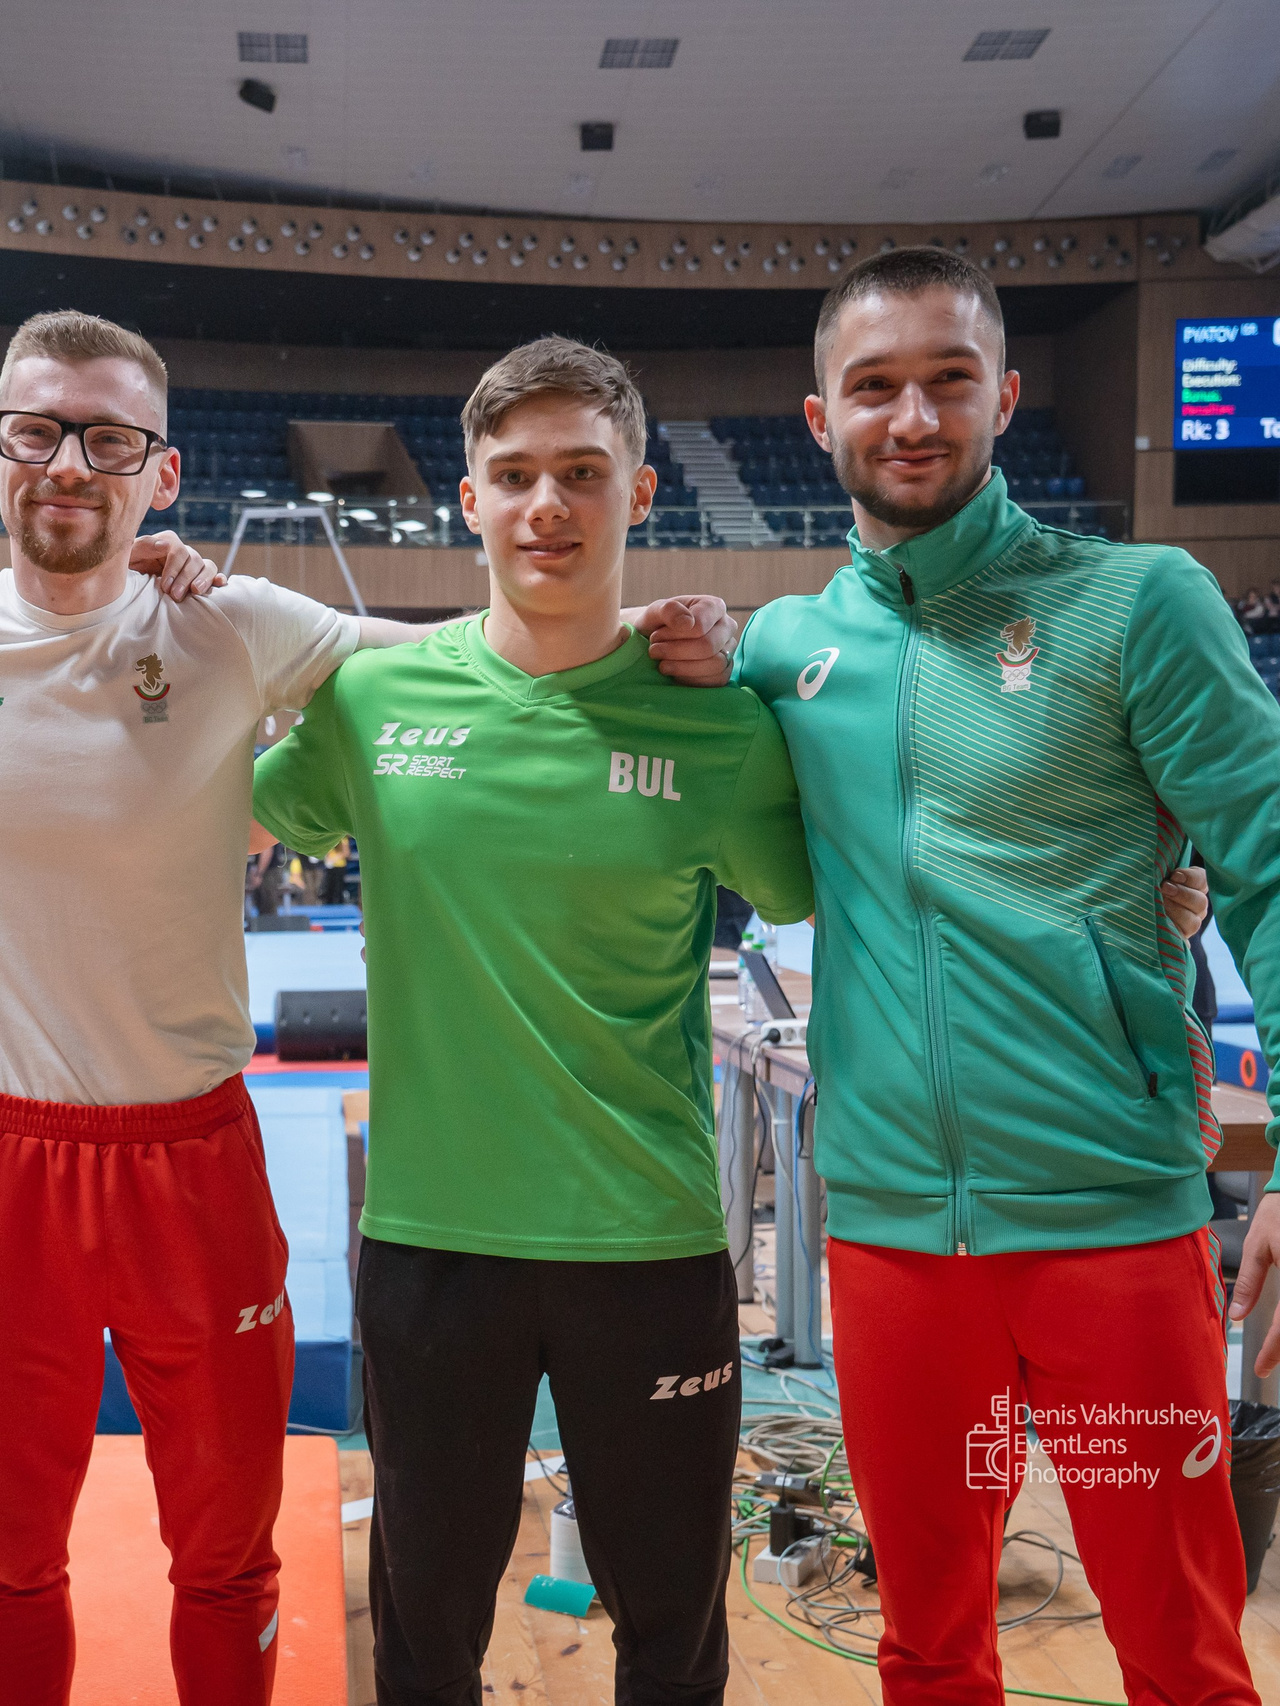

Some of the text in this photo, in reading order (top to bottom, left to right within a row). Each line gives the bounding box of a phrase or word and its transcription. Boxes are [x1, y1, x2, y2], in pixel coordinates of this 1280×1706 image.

[1183, 325, 1240, 344] PYATOV
[1215, 418, 1230, 440] 3
[372, 722, 472, 746] Zeus
[373, 753, 405, 776] SR
[405, 765, 467, 780] RESPECT
[410, 754, 455, 768] SPORT
[608, 751, 681, 802] BUL
[234, 1288, 285, 1334] Zeu
[649, 1361, 733, 1400] Zeus
